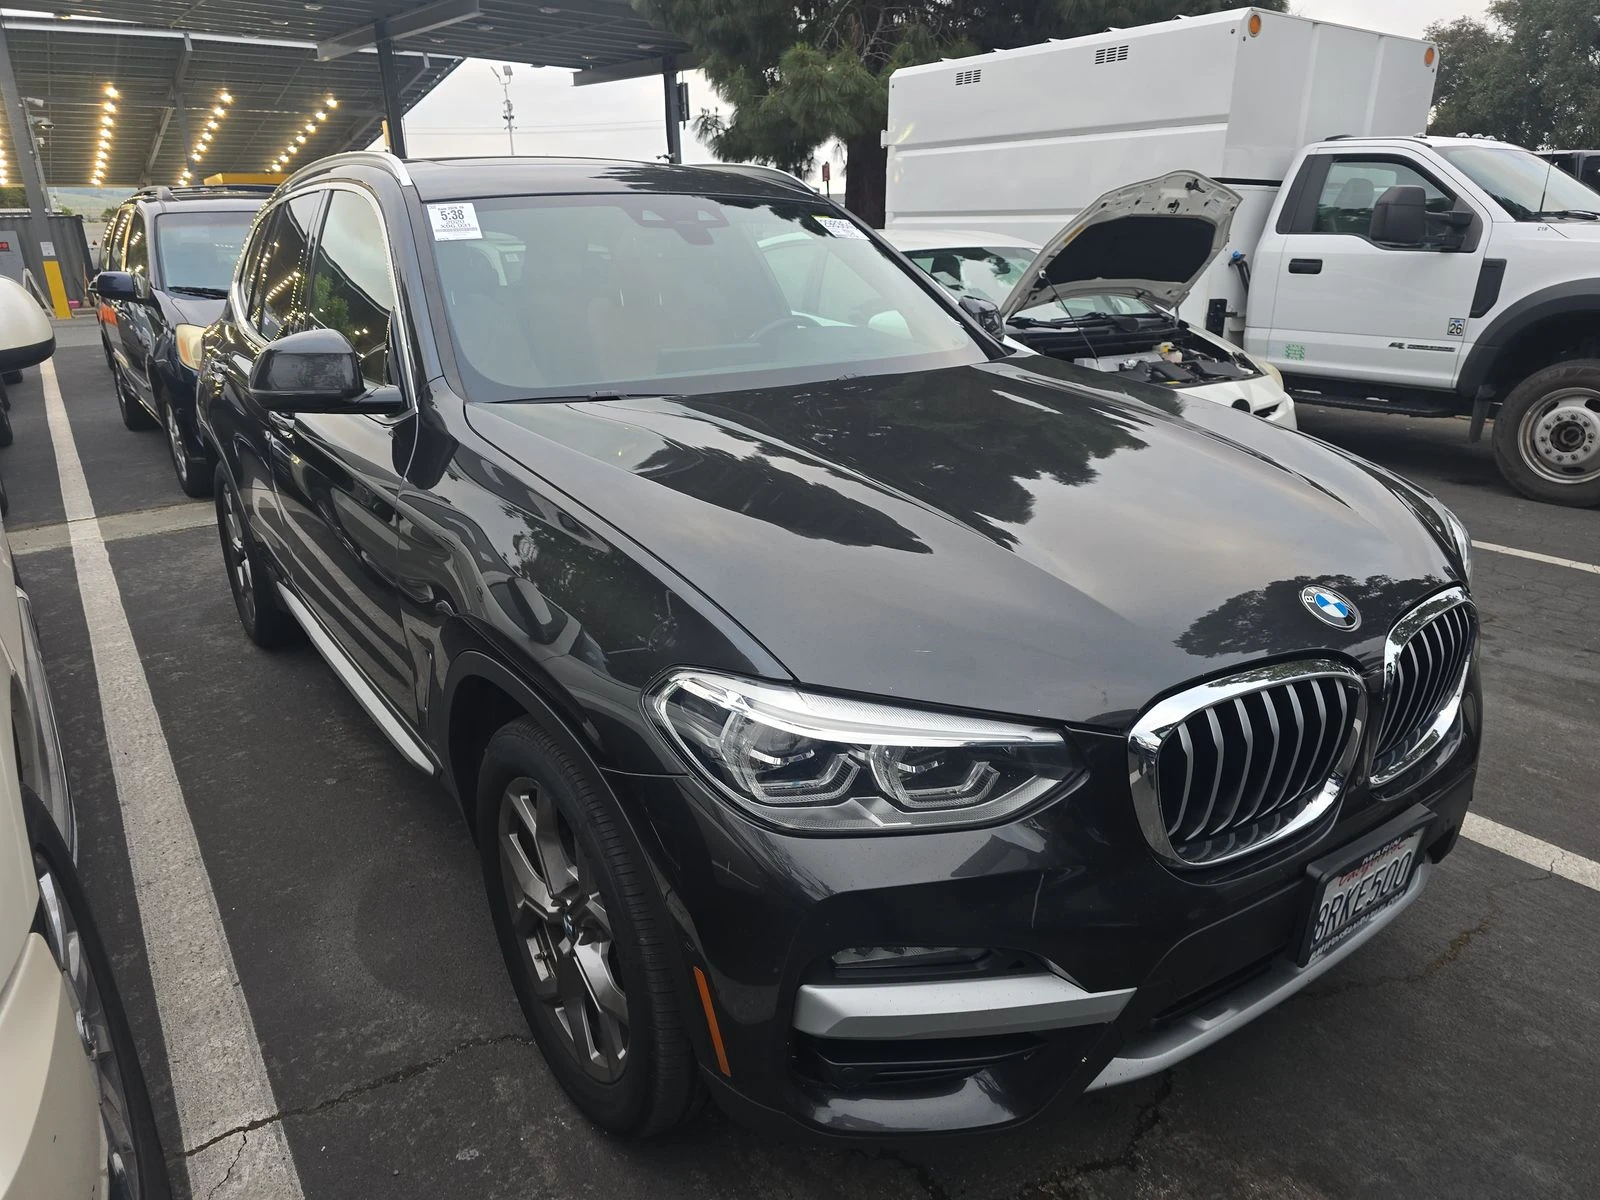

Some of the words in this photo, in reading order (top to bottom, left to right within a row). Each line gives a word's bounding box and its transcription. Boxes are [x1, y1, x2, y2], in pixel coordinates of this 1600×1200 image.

[441, 209, 464, 220] 5:38
[1449, 323, 1463, 335] 26
[1312, 849, 1412, 946] 8RKE500
